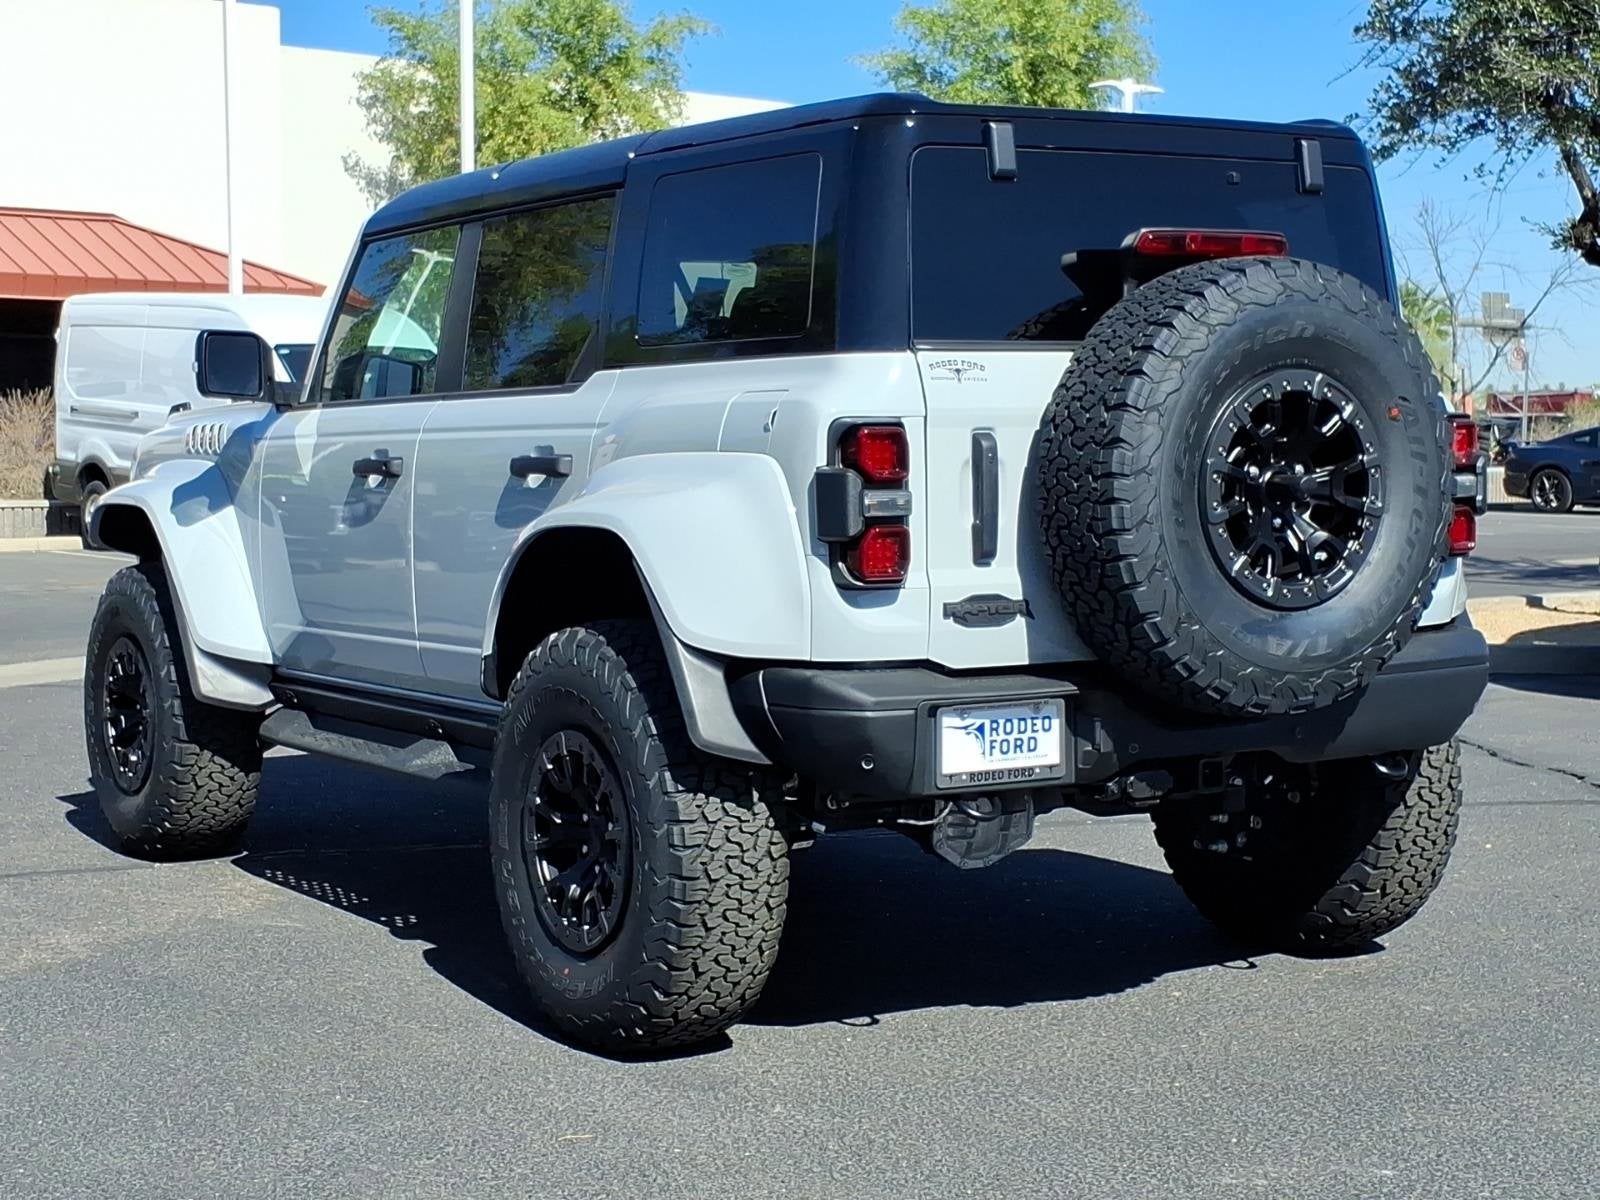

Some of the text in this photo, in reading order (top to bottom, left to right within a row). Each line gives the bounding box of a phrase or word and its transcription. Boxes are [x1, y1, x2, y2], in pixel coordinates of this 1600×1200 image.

[929, 359, 986, 372] RODEO FORD
[989, 715, 1053, 737] RODEO
[989, 736, 1038, 757] FORD
[969, 767, 1035, 783] RODEO FORD
